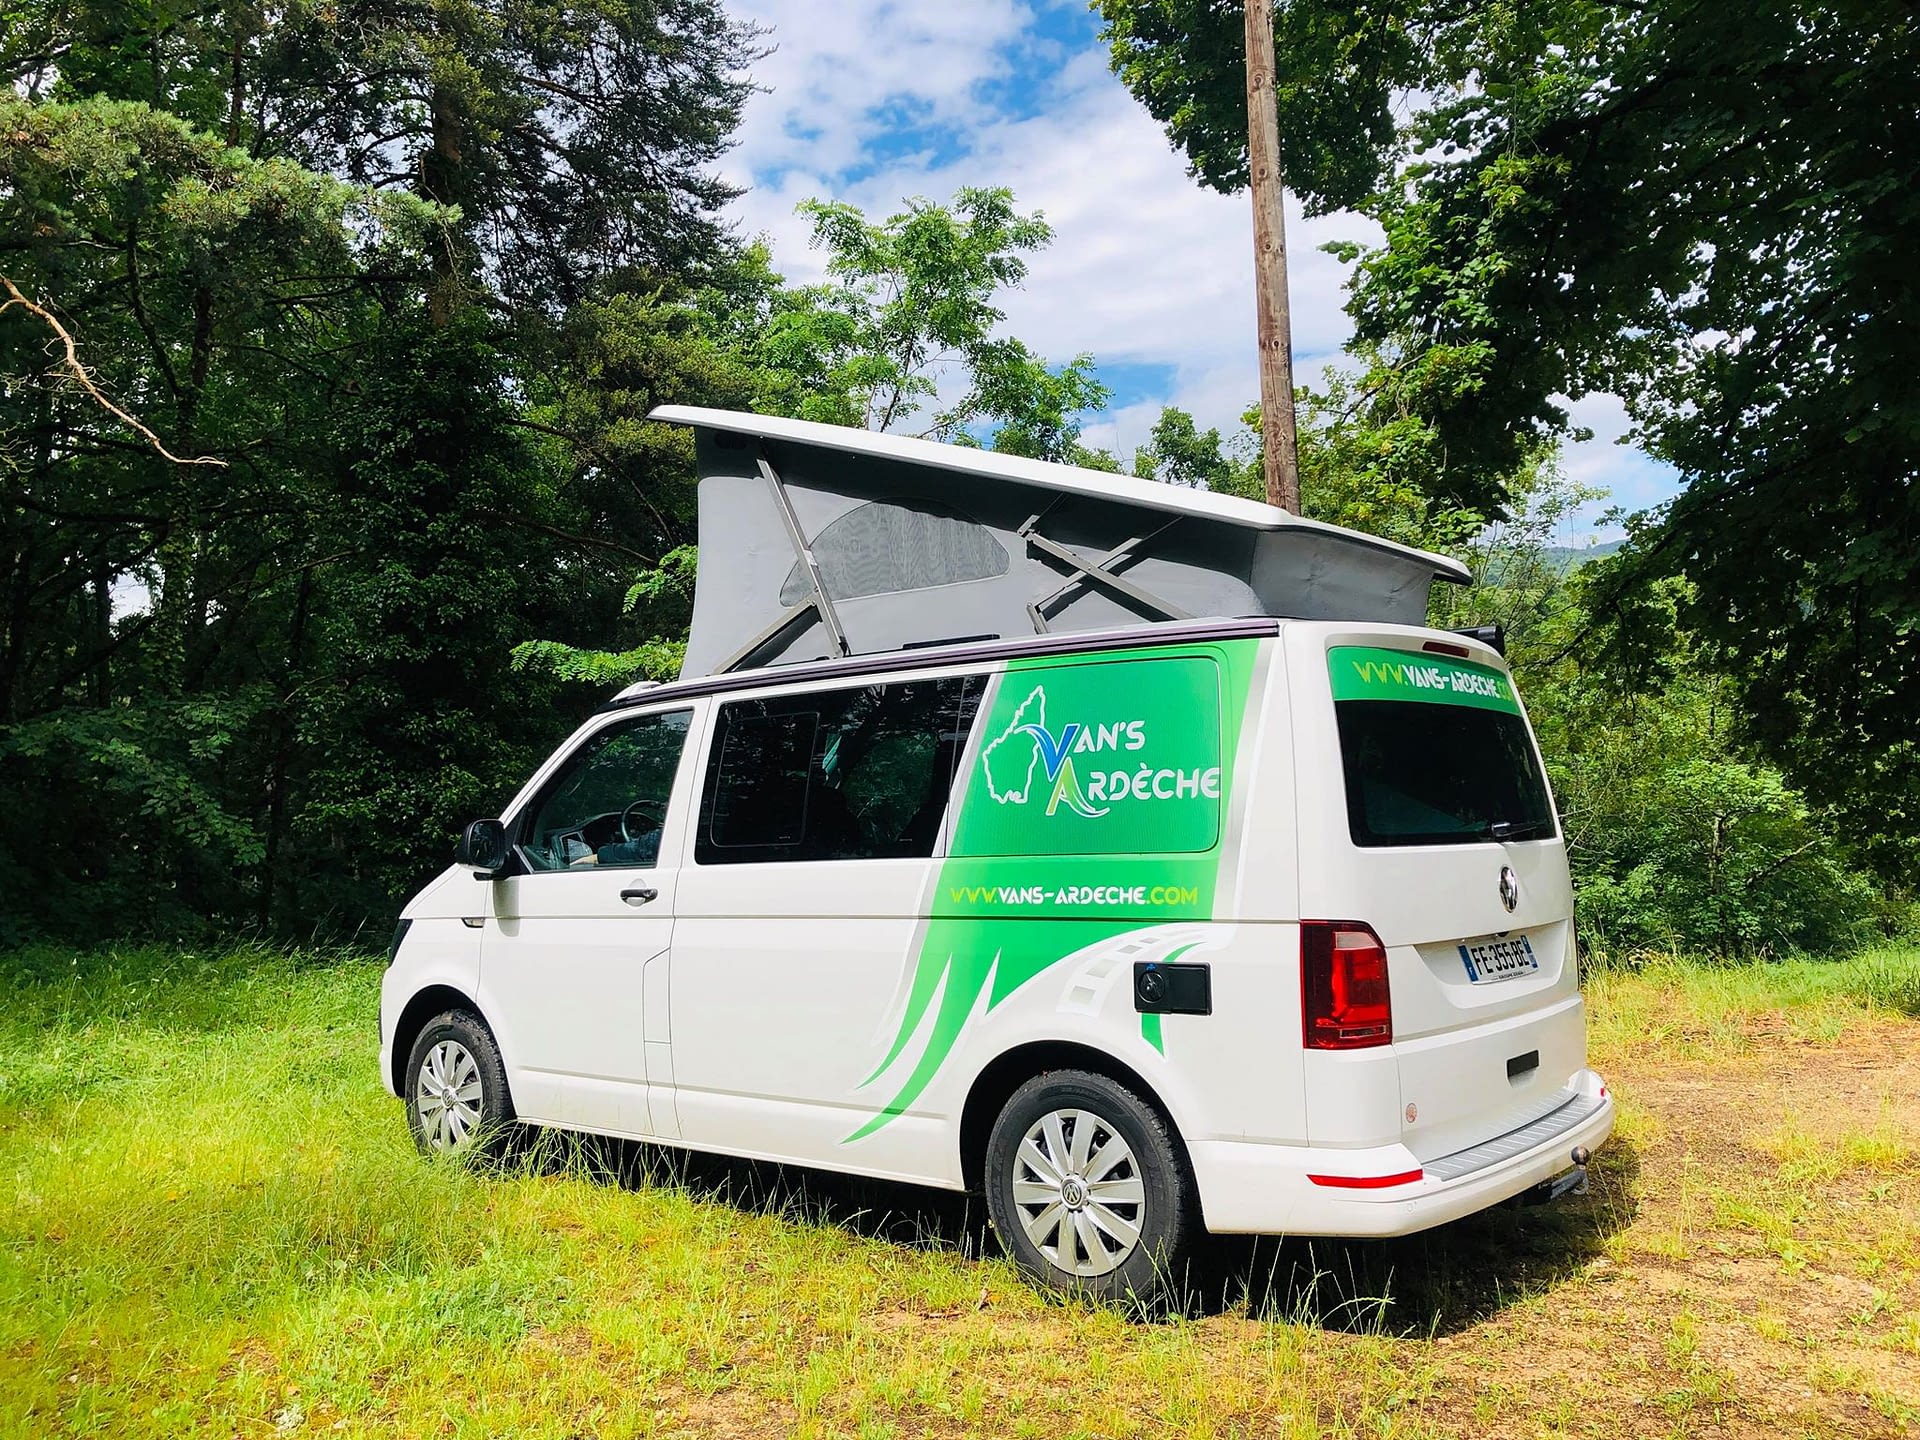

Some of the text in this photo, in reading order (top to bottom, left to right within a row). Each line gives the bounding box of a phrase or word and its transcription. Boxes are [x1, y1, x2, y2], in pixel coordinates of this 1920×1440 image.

[1014, 720, 1146, 782] VAN'S
[1046, 757, 1221, 818] ARDÈCHE
[950, 886, 1198, 905] WWW.VANS-ARDECHE.COM
